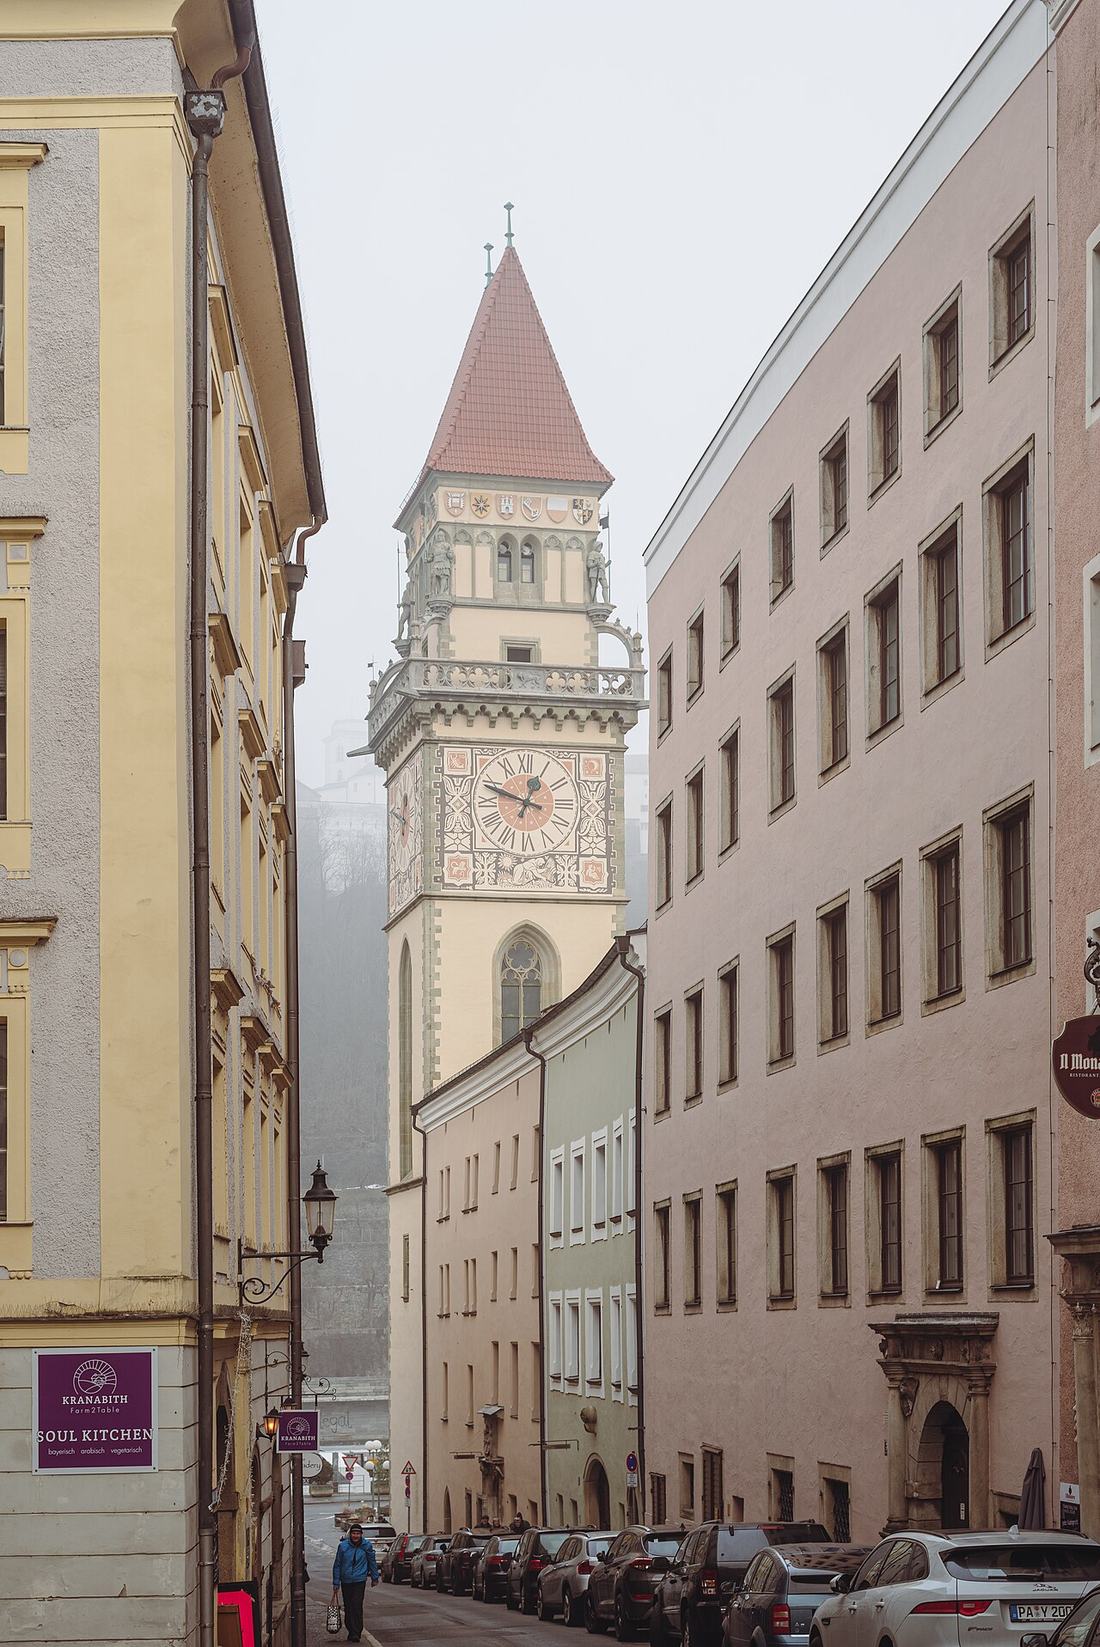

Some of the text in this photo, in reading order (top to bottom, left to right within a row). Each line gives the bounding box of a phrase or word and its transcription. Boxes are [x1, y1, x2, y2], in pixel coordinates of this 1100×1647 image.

[518, 754, 533, 774] XII
[554, 799, 574, 810] III
[62, 1395, 128, 1405] KRANABITH
[37, 1428, 153, 1442] SOUL KITCHEN
[48, 1448, 76, 1456] bayerisch
[111, 1446, 143, 1456] vegetarisch
[1018, 1606, 1033, 1617] PA
[1041, 1606, 1048, 1617] Y
